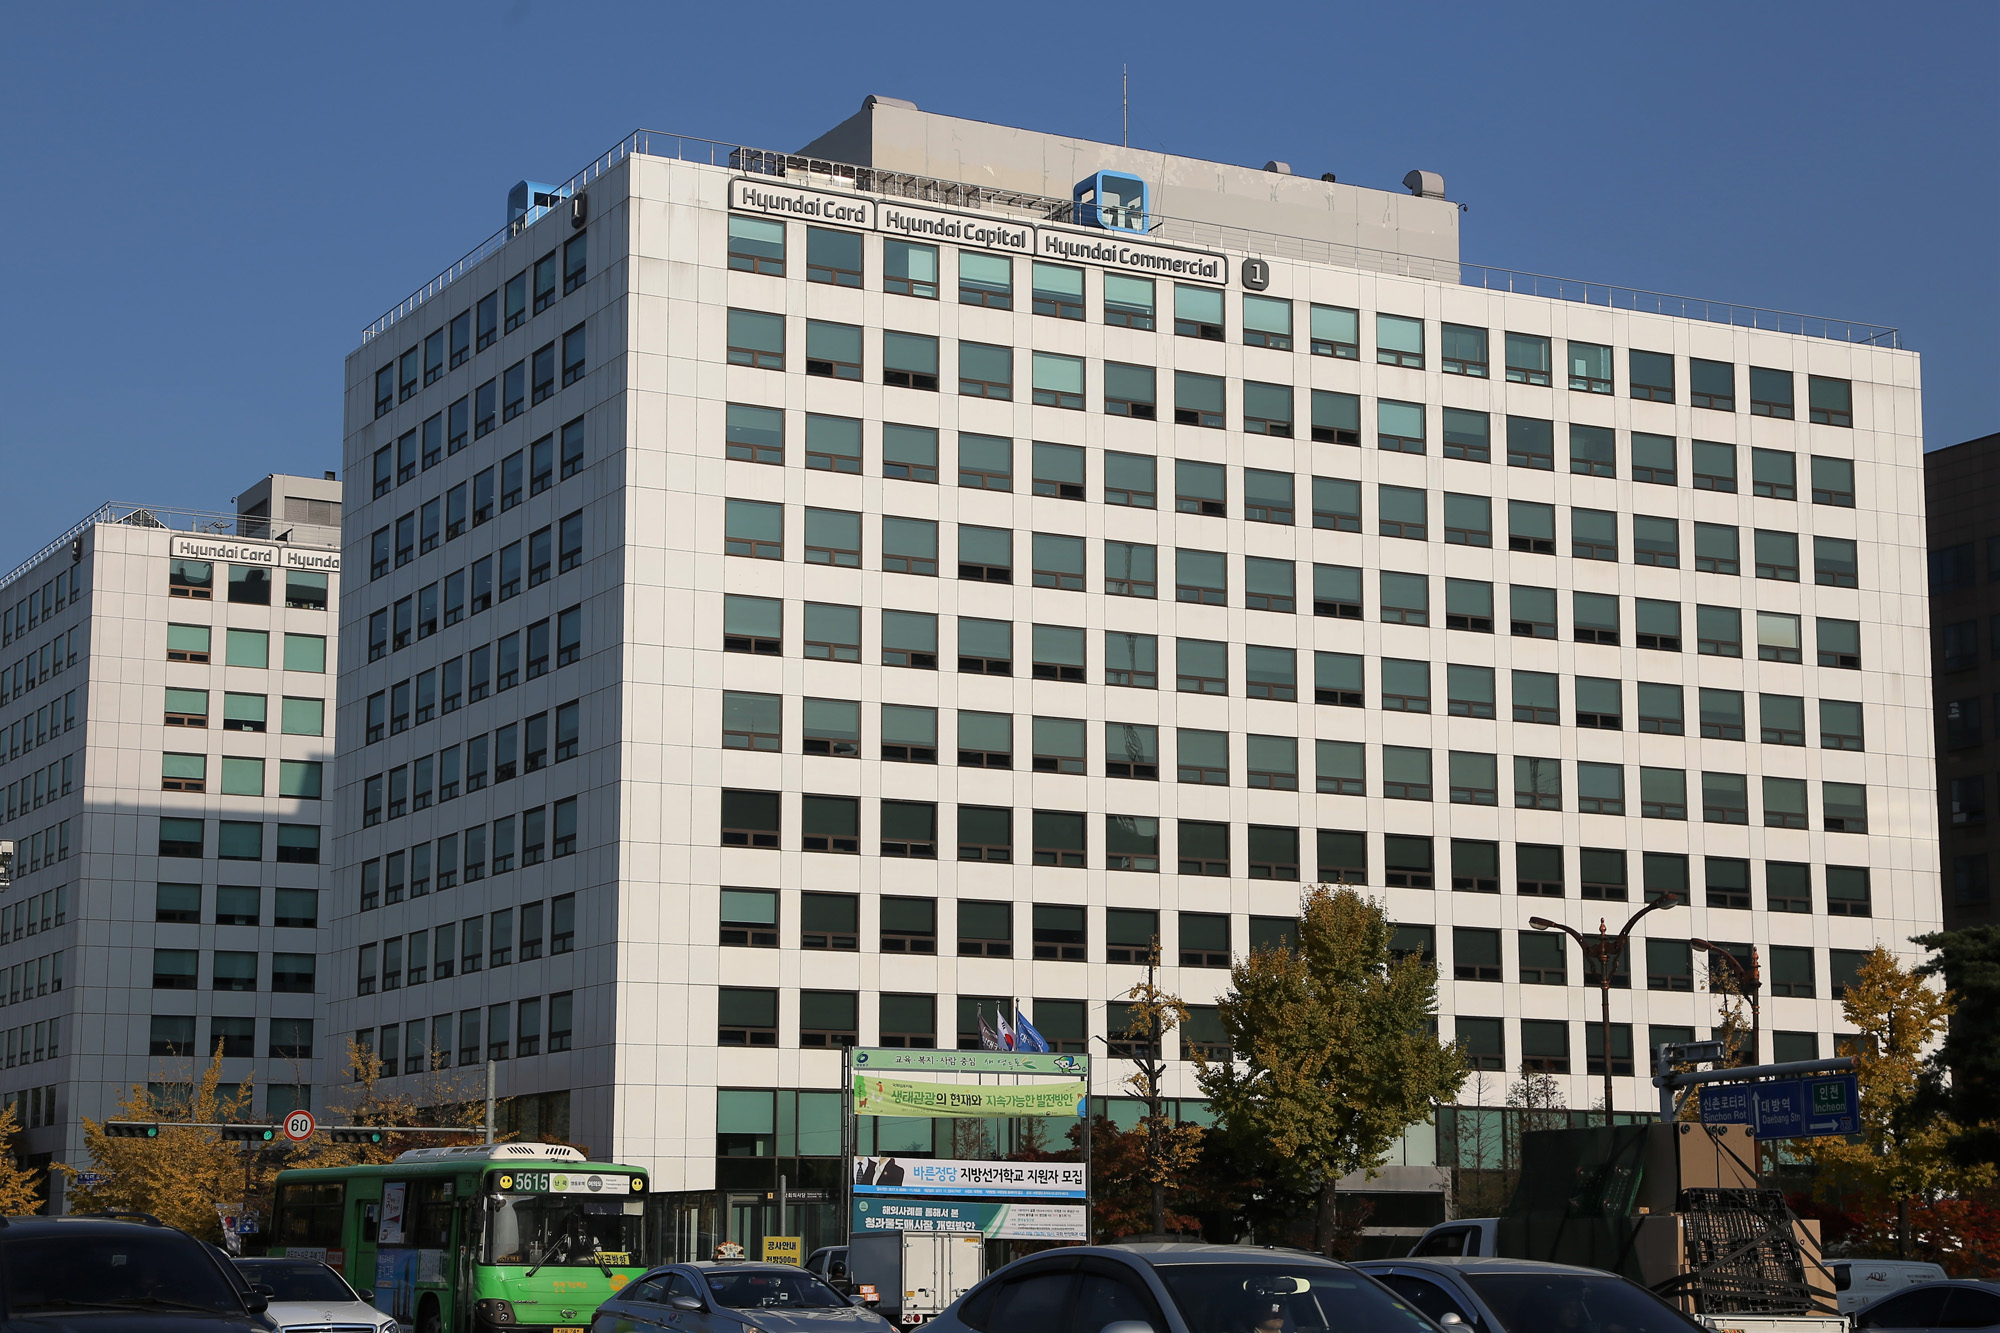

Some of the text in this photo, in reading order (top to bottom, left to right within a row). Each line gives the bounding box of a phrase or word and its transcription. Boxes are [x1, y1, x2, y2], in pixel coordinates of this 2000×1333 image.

[742, 187, 866, 224] Hyundai Card
[886, 210, 1026, 249] Hyundai Capital
[1045, 235, 1218, 279] Hyundai Commercial
[1250, 263, 1264, 284] 1
[180, 541, 272, 563] Hyundai Card
[287, 552, 340, 569] Hyunda
[895, 1055, 976, 1067] 교육 복지 사람 중심
[891, 1090, 1073, 1108] 생태관광의 현재와 지속가능한 발전방안
[1819, 1085, 1839, 1100] 인천
[1703, 1094, 1747, 1111] 신촌로터리
[1761, 1097, 1791, 1113] 대방역
[1814, 1102, 1846, 1112] Incheon
[1703, 1110, 1747, 1122] Sinchon Rot
[1762, 1112, 1800, 1125] Daebang Stn
[290, 1118, 309, 1133] 60
[516, 1173, 548, 1191] 5615
[913, 1166, 1083, 1185] 바른정당 지방선거학교 지원자 모집
[882, 1205, 923, 1217] 해외사례를
[925, 1207, 949, 1218] 통해서
[767, 1241, 797, 1251] 공사안내
